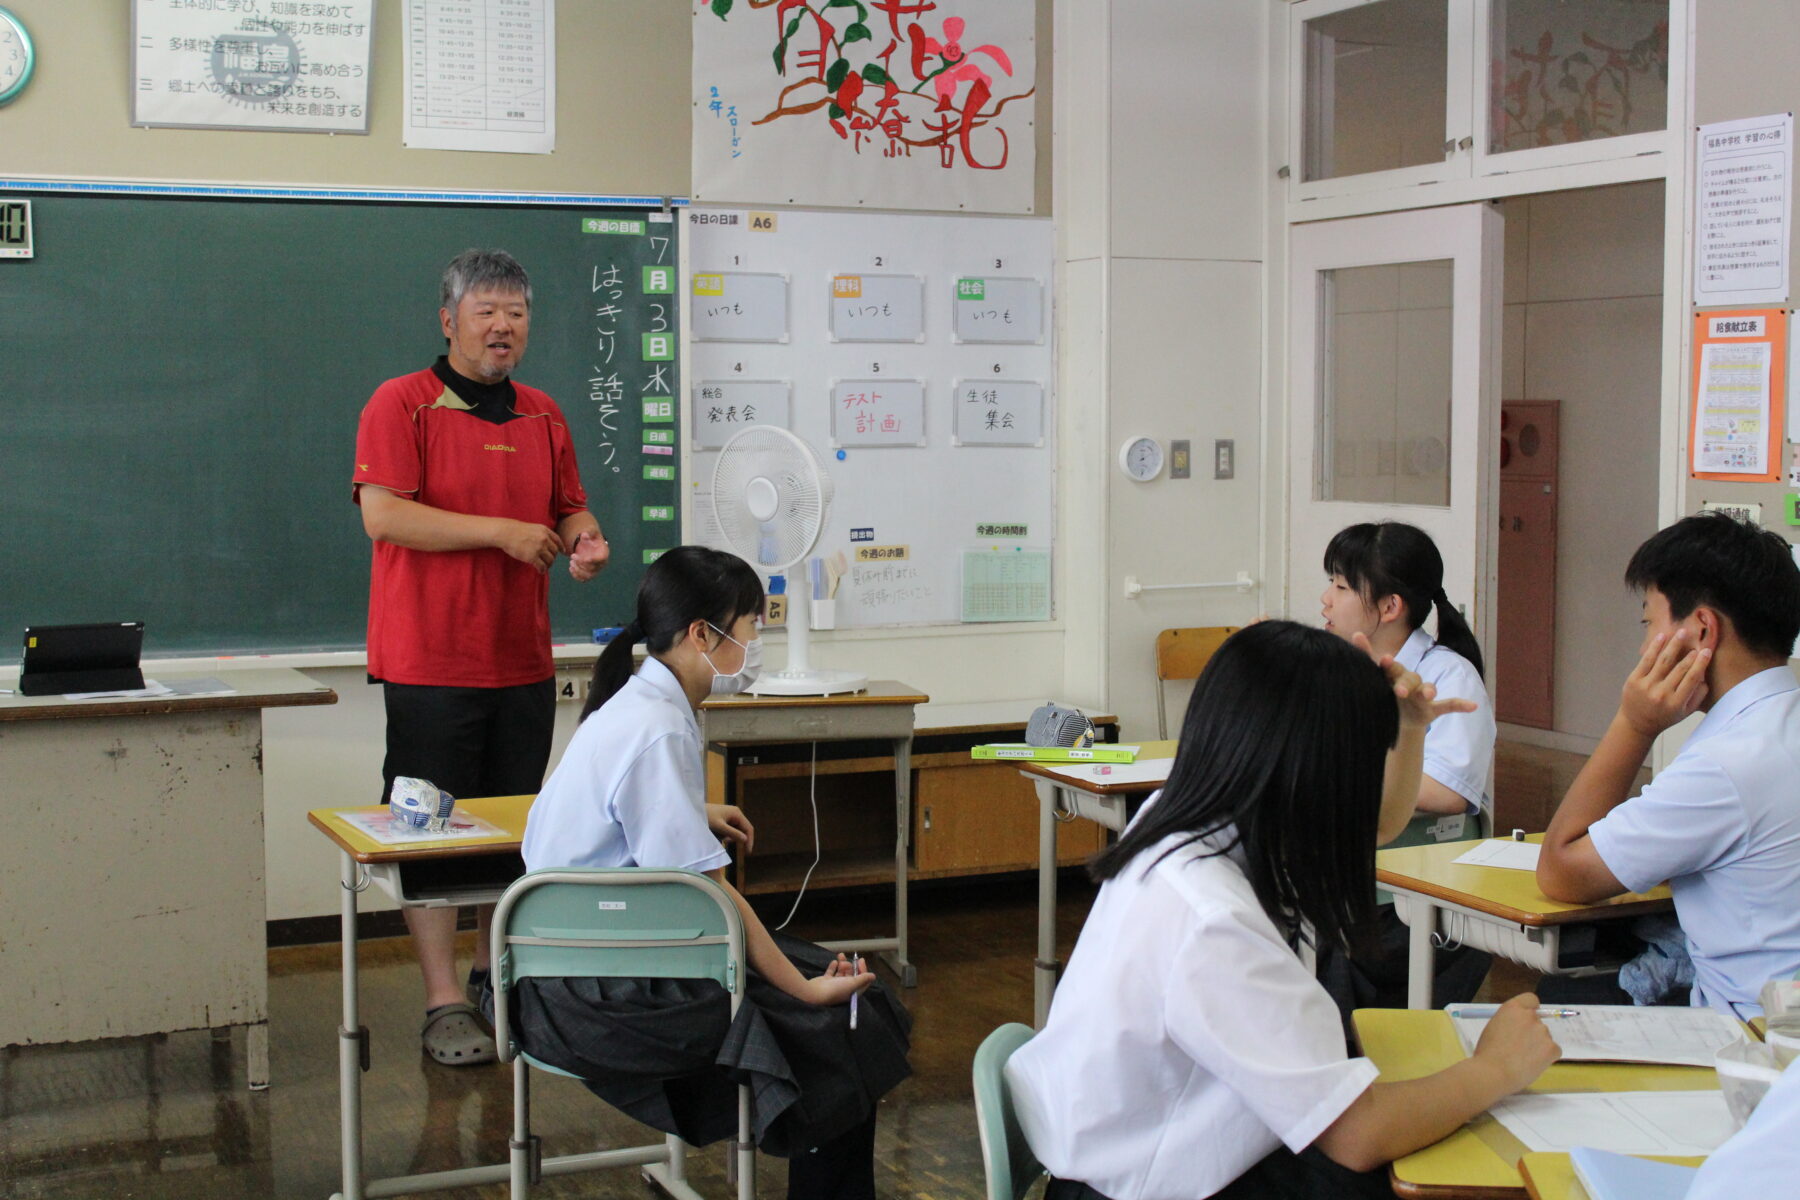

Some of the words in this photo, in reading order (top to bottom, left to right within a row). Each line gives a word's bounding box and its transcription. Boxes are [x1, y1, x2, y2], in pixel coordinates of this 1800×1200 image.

[3, 31, 11, 43] 2
[9, 49, 17, 60] 3
[5, 65, 13, 76] 4
[255, 61, 364, 78] お互いに高め合う
[267, 101, 363, 118] 未来を創造する
[709, 86, 723, 119] 2年
[727, 106, 741, 158] スローガン
[1708, 136, 1741, 149] 福島中学校
[1744, 130, 1781, 144] 学習の心得
[587, 220, 640, 233] 今週の目標
[689, 213, 739, 226] 今日の日課
[753, 217, 772, 230] A6
[875, 257, 883, 267] 2
[995, 259, 1003, 269] 3
[834, 278, 860, 293] 理科
[959, 281, 984, 296] 社会
[707, 302, 744, 317] いつも
[848, 303, 893, 318] いつも
[972, 308, 1013, 324] いつも
[1716, 320, 1758, 334] 給食献立表
[734, 363, 742, 373] 4
[872, 363, 880, 373] 5
[993, 363, 1001, 373] 6
[702, 387, 723, 400] 総合
[843, 391, 883, 408] テスト
[966, 388, 1000, 405] 生徒
[707, 404, 758, 423] 発表会
[985, 409, 1016, 431] 集会
[854, 410, 901, 433] 計画
[977, 525, 1028, 536] 今週の時間割
[861, 547, 905, 559] 今週のお題
[769, 601, 781, 619] A5
[562, 681, 574, 697] 4
